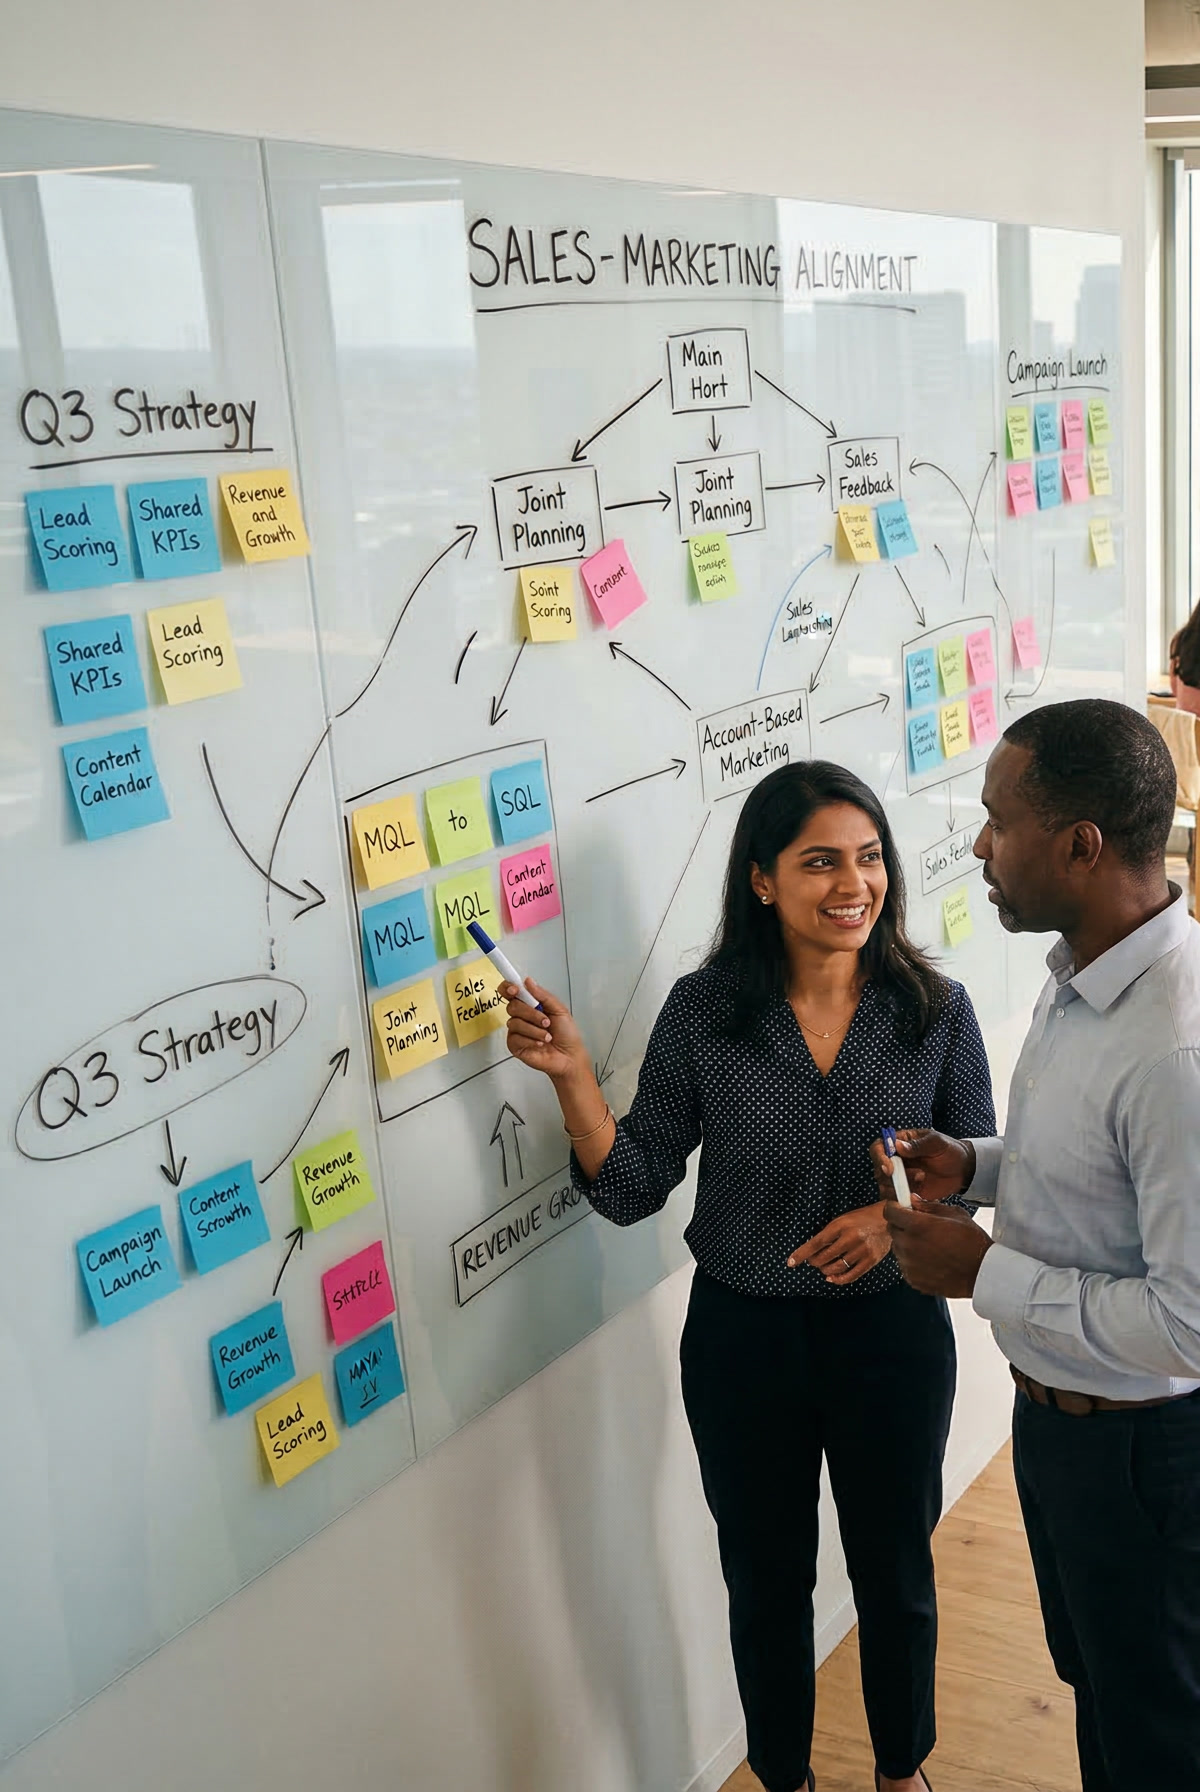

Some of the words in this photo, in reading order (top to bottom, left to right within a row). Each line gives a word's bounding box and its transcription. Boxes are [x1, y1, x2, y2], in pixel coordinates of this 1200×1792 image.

[468, 217, 781, 289] SALES-MARKETING
[795, 248, 919, 293] ALIGNMENT
[682, 340, 723, 368] Main
[1006, 349, 1065, 392] Campaign
[1069, 353, 1108, 377] Launch
[690, 373, 729, 400] Hort
[20, 388, 94, 448] Q3
[113, 388, 257, 453] Strategy
[844, 445, 879, 469] Sales
[227, 485, 287, 505] Revenue
[694, 467, 735, 493] Joint
[839, 471, 896, 500] Feedback
[139, 494, 203, 521] Shared
[251, 505, 278, 523] and
[516, 481, 567, 515] Joint
[690, 498, 753, 528] Planning
[39, 503, 92, 530] Lead
[43, 538, 119, 567] Scoring
[152, 528, 201, 555] KPIs
[245, 524, 297, 548] Growth
[512, 520, 586, 553] Planning
[161, 614, 204, 642] Lead
[530, 603, 573, 624] Scoring
[56, 631, 125, 664] Shared
[162, 644, 225, 669] Scoring
[70, 667, 123, 696] KPIs
[702, 697, 804, 754] Account-Based
[75, 743, 142, 778] Content
[719, 740, 790, 782] Marketing
[79, 773, 153, 807] Calendar
[363, 820, 416, 858] MQL
[447, 808, 468, 831] to
[500, 783, 542, 817] SQL
[510, 882, 555, 909] Calendar
[373, 916, 426, 956] MQL
[443, 890, 491, 928] MQL
[454, 978, 486, 1001] Sales
[382, 1001, 418, 1032] Joint
[386, 1021, 440, 1056] Planning
[36, 1050, 120, 1130] Q3
[137, 999, 278, 1084] Strategy
[302, 1151, 357, 1186] Revenue
[188, 1182, 241, 1217] Content
[311, 1169, 361, 1206] Growth
[86, 1227, 163, 1273] Campaign
[462, 1203, 543, 1280] REVENUE
[98, 1255, 162, 1298] Launch
[218, 1325, 279, 1369] Revenue
[227, 1349, 282, 1390] Growth
[266, 1401, 305, 1440] Lead
[272, 1419, 328, 1460] Scoring
